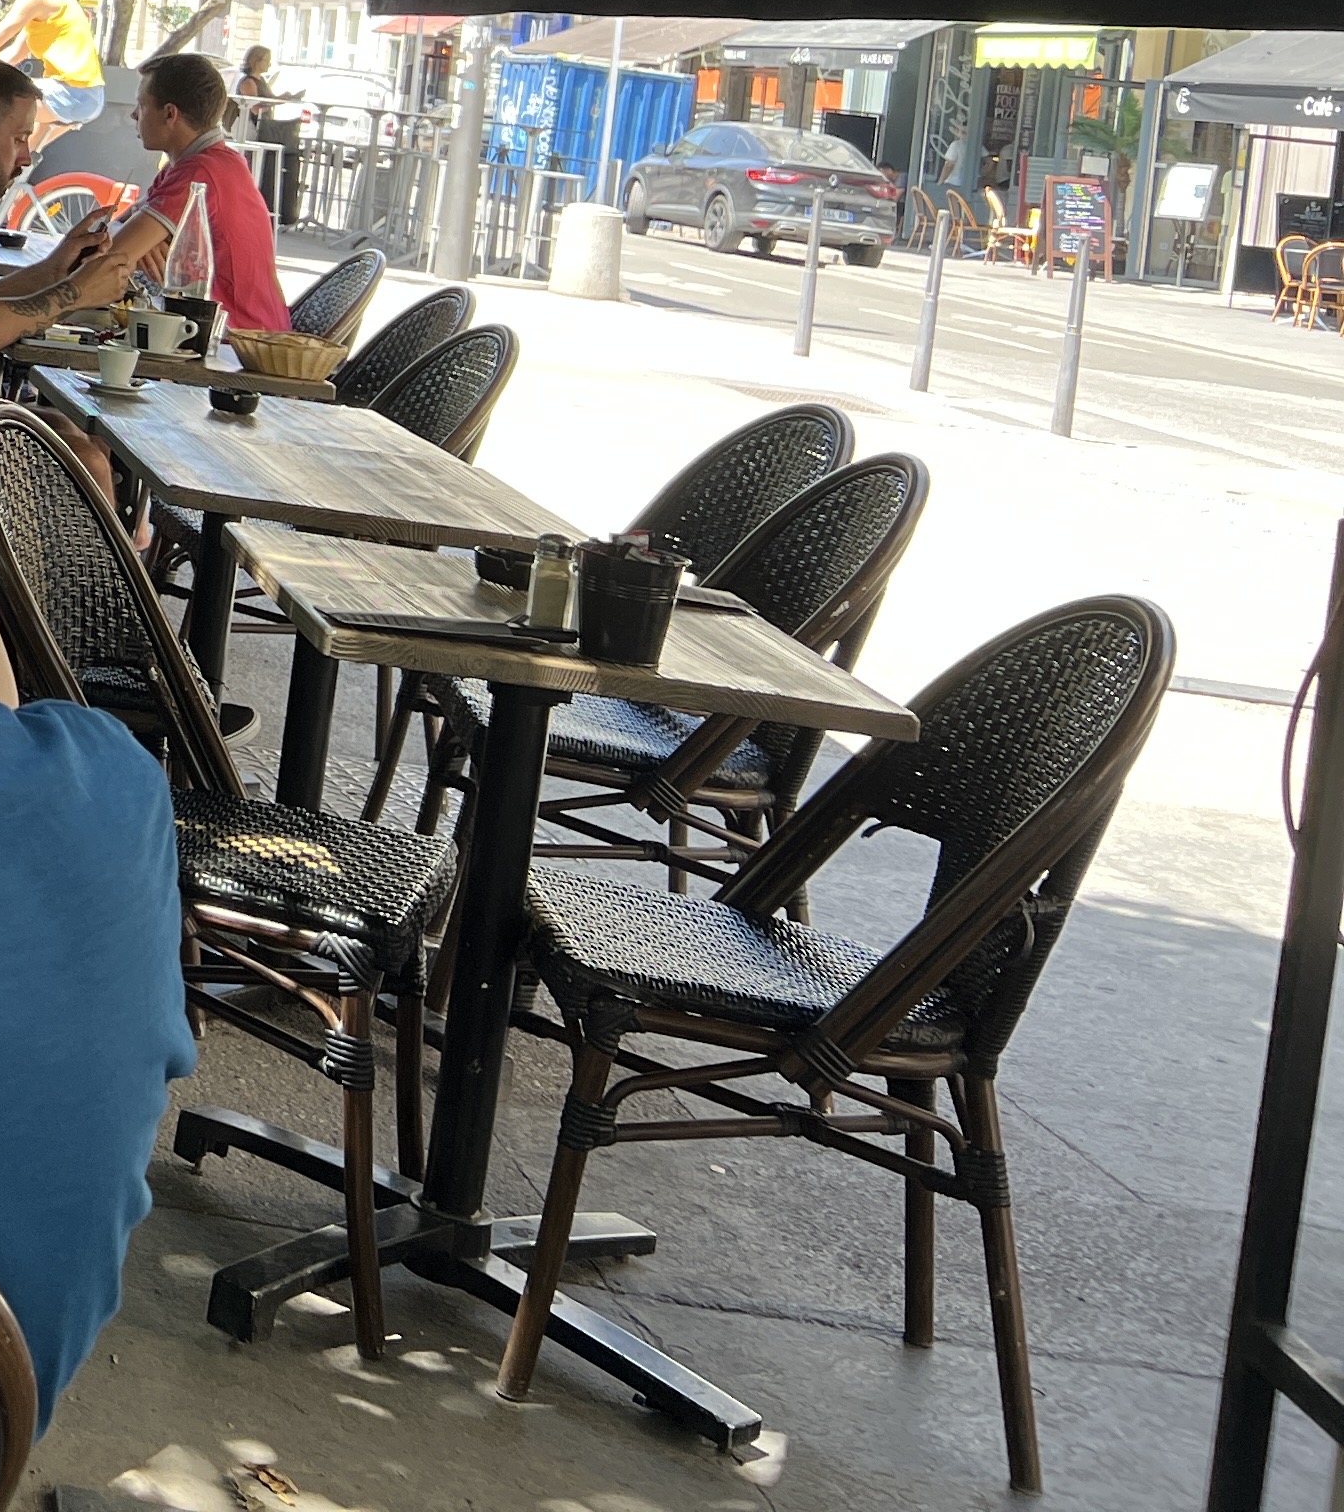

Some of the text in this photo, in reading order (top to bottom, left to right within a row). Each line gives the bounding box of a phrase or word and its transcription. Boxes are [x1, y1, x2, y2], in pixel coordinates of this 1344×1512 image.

[995, 94, 1017, 108] FOO
[1303, 96, 1334, 117] Café
[994, 107, 1017, 120] PIZZ
